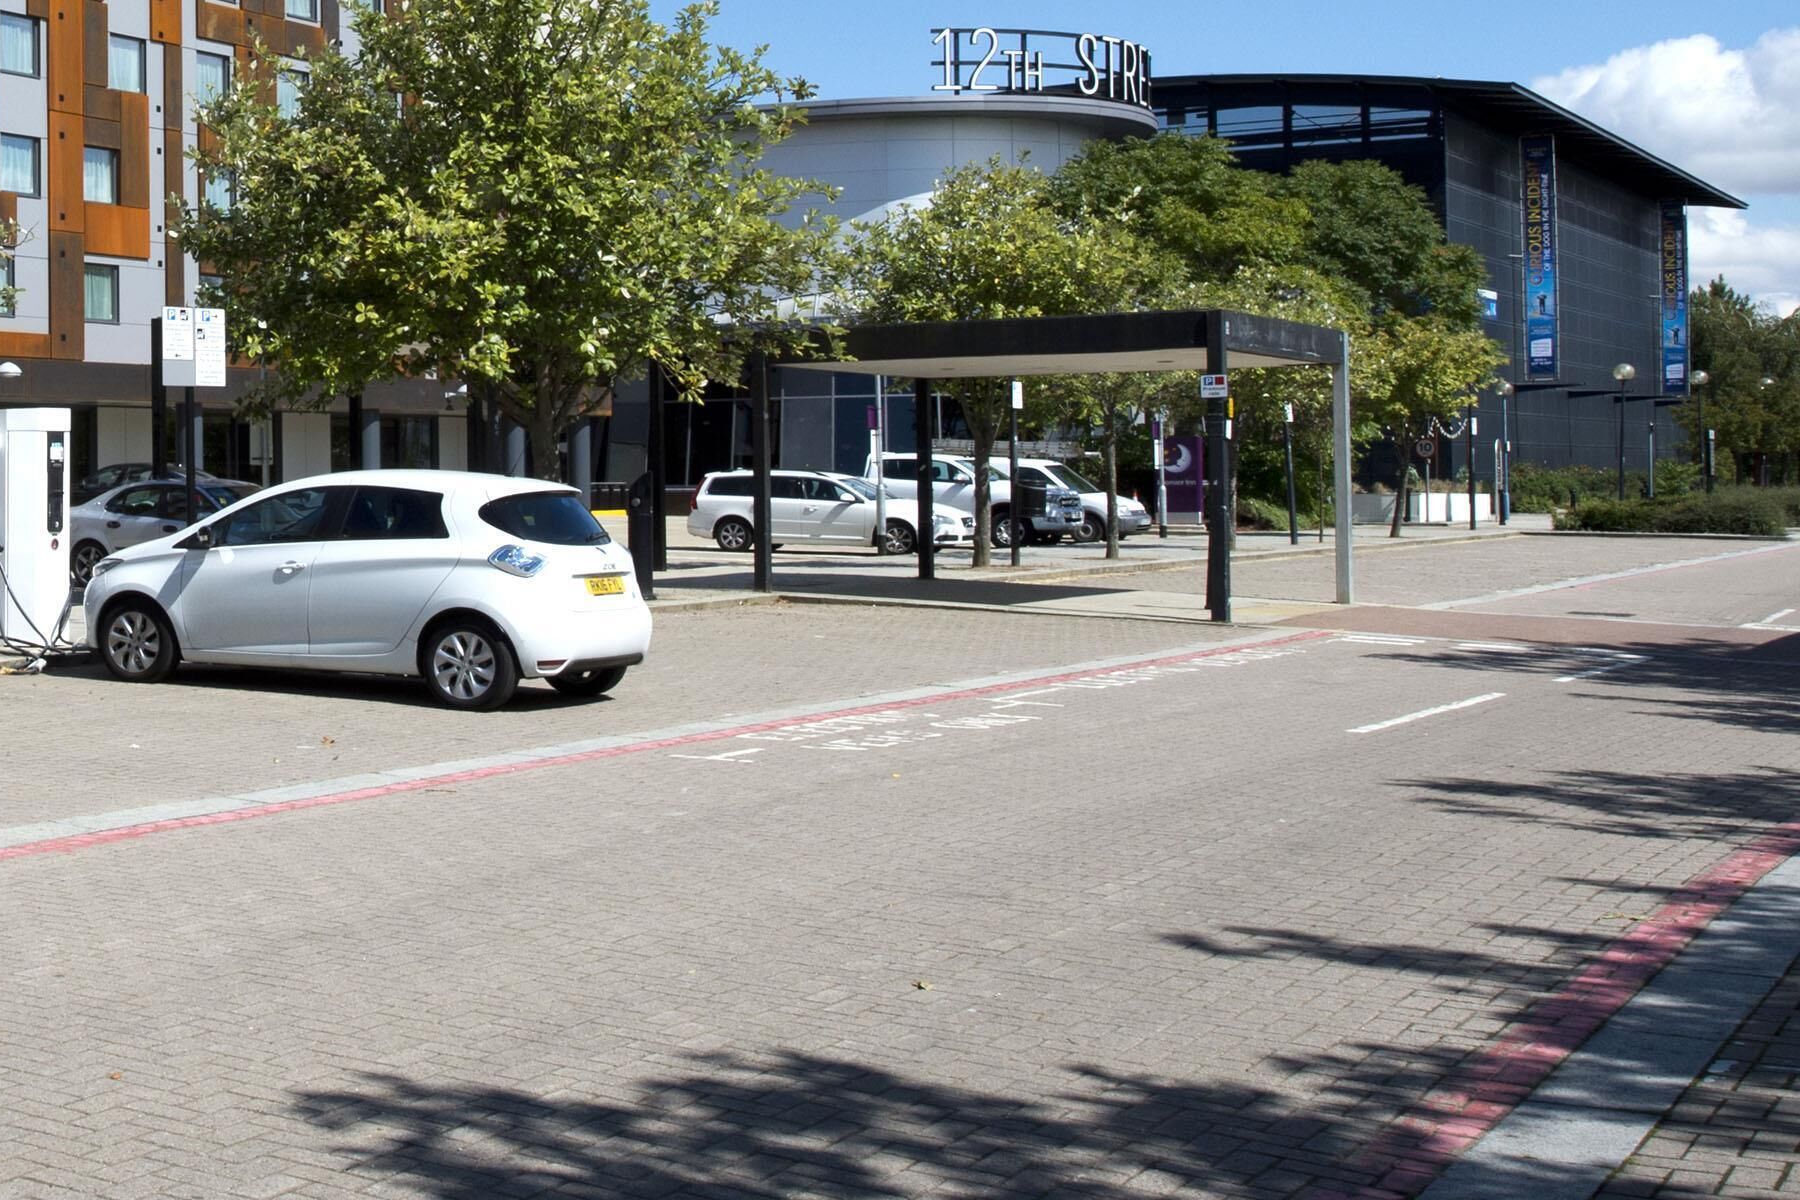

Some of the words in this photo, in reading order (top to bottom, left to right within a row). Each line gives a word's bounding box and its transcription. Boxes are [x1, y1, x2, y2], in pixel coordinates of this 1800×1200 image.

[932, 28, 1043, 91] 12TH
[1078, 33, 1152, 109] STRE
[1527, 160, 1541, 223] INCIDENT
[1542, 210, 1550, 221] THE
[1542, 232, 1551, 247] DOG
[1529, 226, 1543, 286] CURIOUS
[1543, 249, 1551, 260] THE
[1543, 262, 1551, 271] OF
[1420, 442, 1432, 452] 10
